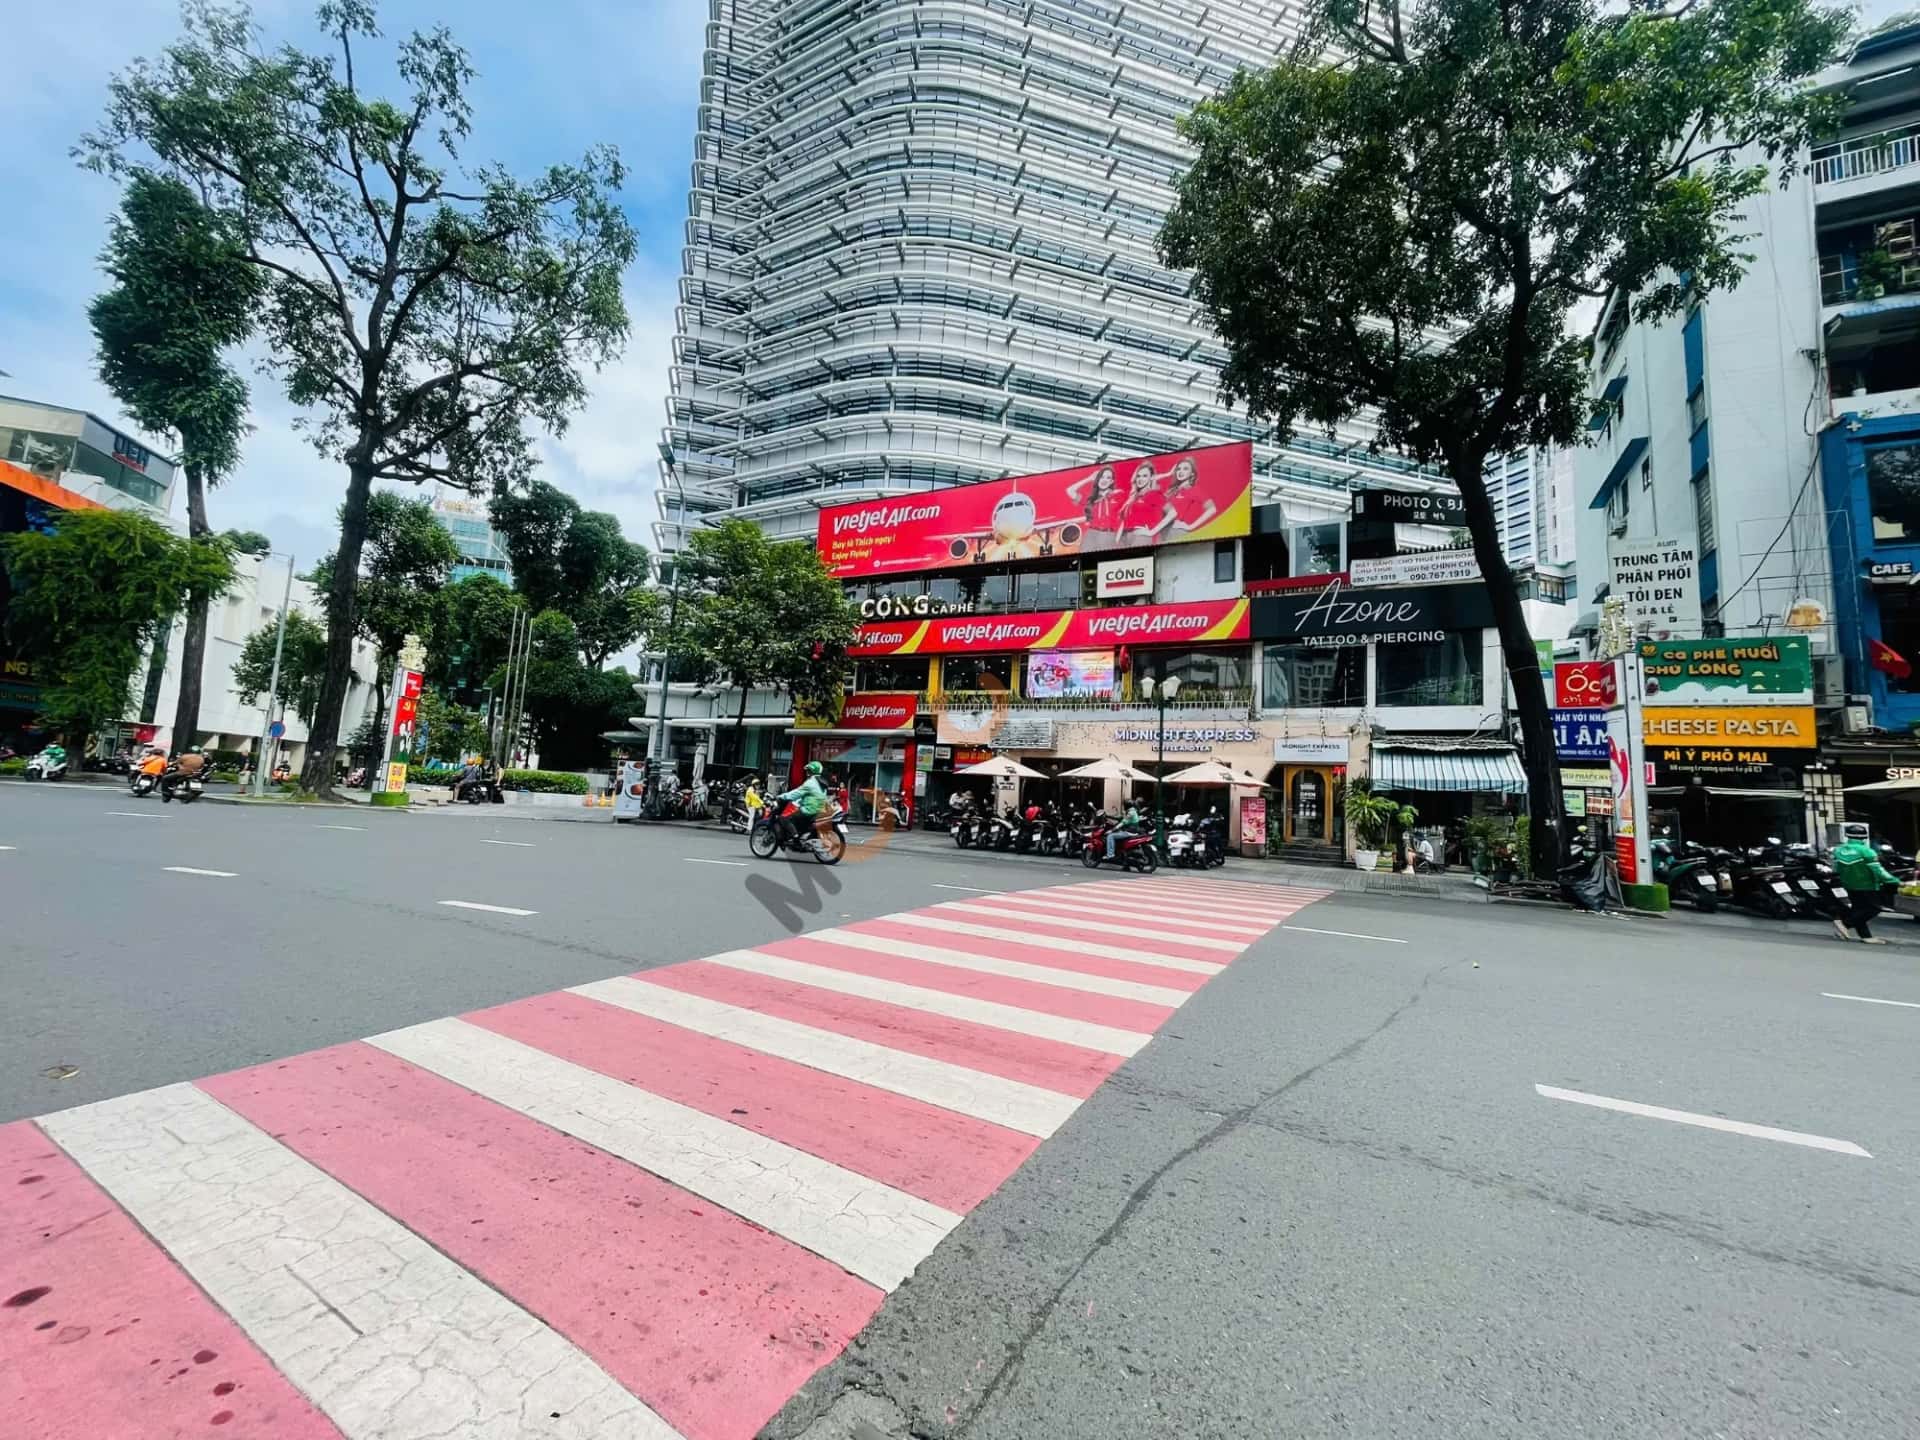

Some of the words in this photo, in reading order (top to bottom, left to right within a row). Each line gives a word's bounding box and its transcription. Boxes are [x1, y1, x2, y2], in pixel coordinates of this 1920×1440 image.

[1383, 494, 1431, 509] PHOTO
[1613, 553, 1659, 567] TRUNG
[1662, 549, 1693, 563] TÂM
[1616, 568, 1653, 584] PHÂN
[1658, 563, 1691, 580] PHỐI
[1871, 562, 1912, 575] CAFE
[1654, 587, 1683, 600] ĐEN
[1294, 577, 1421, 632] Azone
[1302, 634, 1358, 647] TATTOO
[1360, 633, 1369, 644] &
[1373, 630, 1445, 644] PIERCING
[1688, 663, 1742, 676] LONG
[1183, 729, 1256, 742] EXPRESS
[1725, 719, 1800, 736] PASTA
[1663, 748, 1680, 761] MÌ
[1686, 747, 1696, 761] Ý
[1701, 748, 1734, 762] PHÔ
[1738, 751, 1768, 763] MAI
